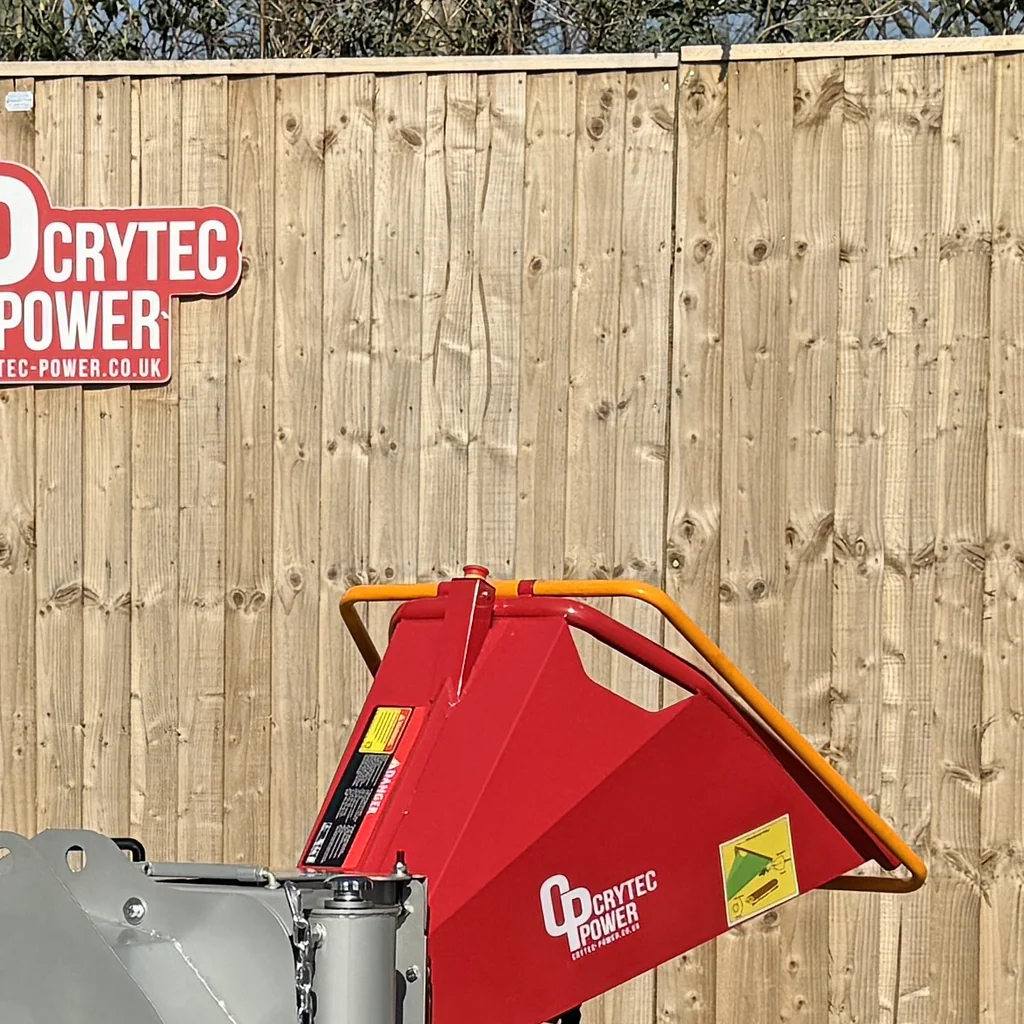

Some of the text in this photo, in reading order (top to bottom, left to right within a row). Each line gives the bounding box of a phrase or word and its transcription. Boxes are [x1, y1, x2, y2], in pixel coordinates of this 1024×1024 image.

[43, 219, 227, 284] CRYTEC
[592, 869, 658, 916] CRYTEC
[579, 901, 639, 947] POWER
